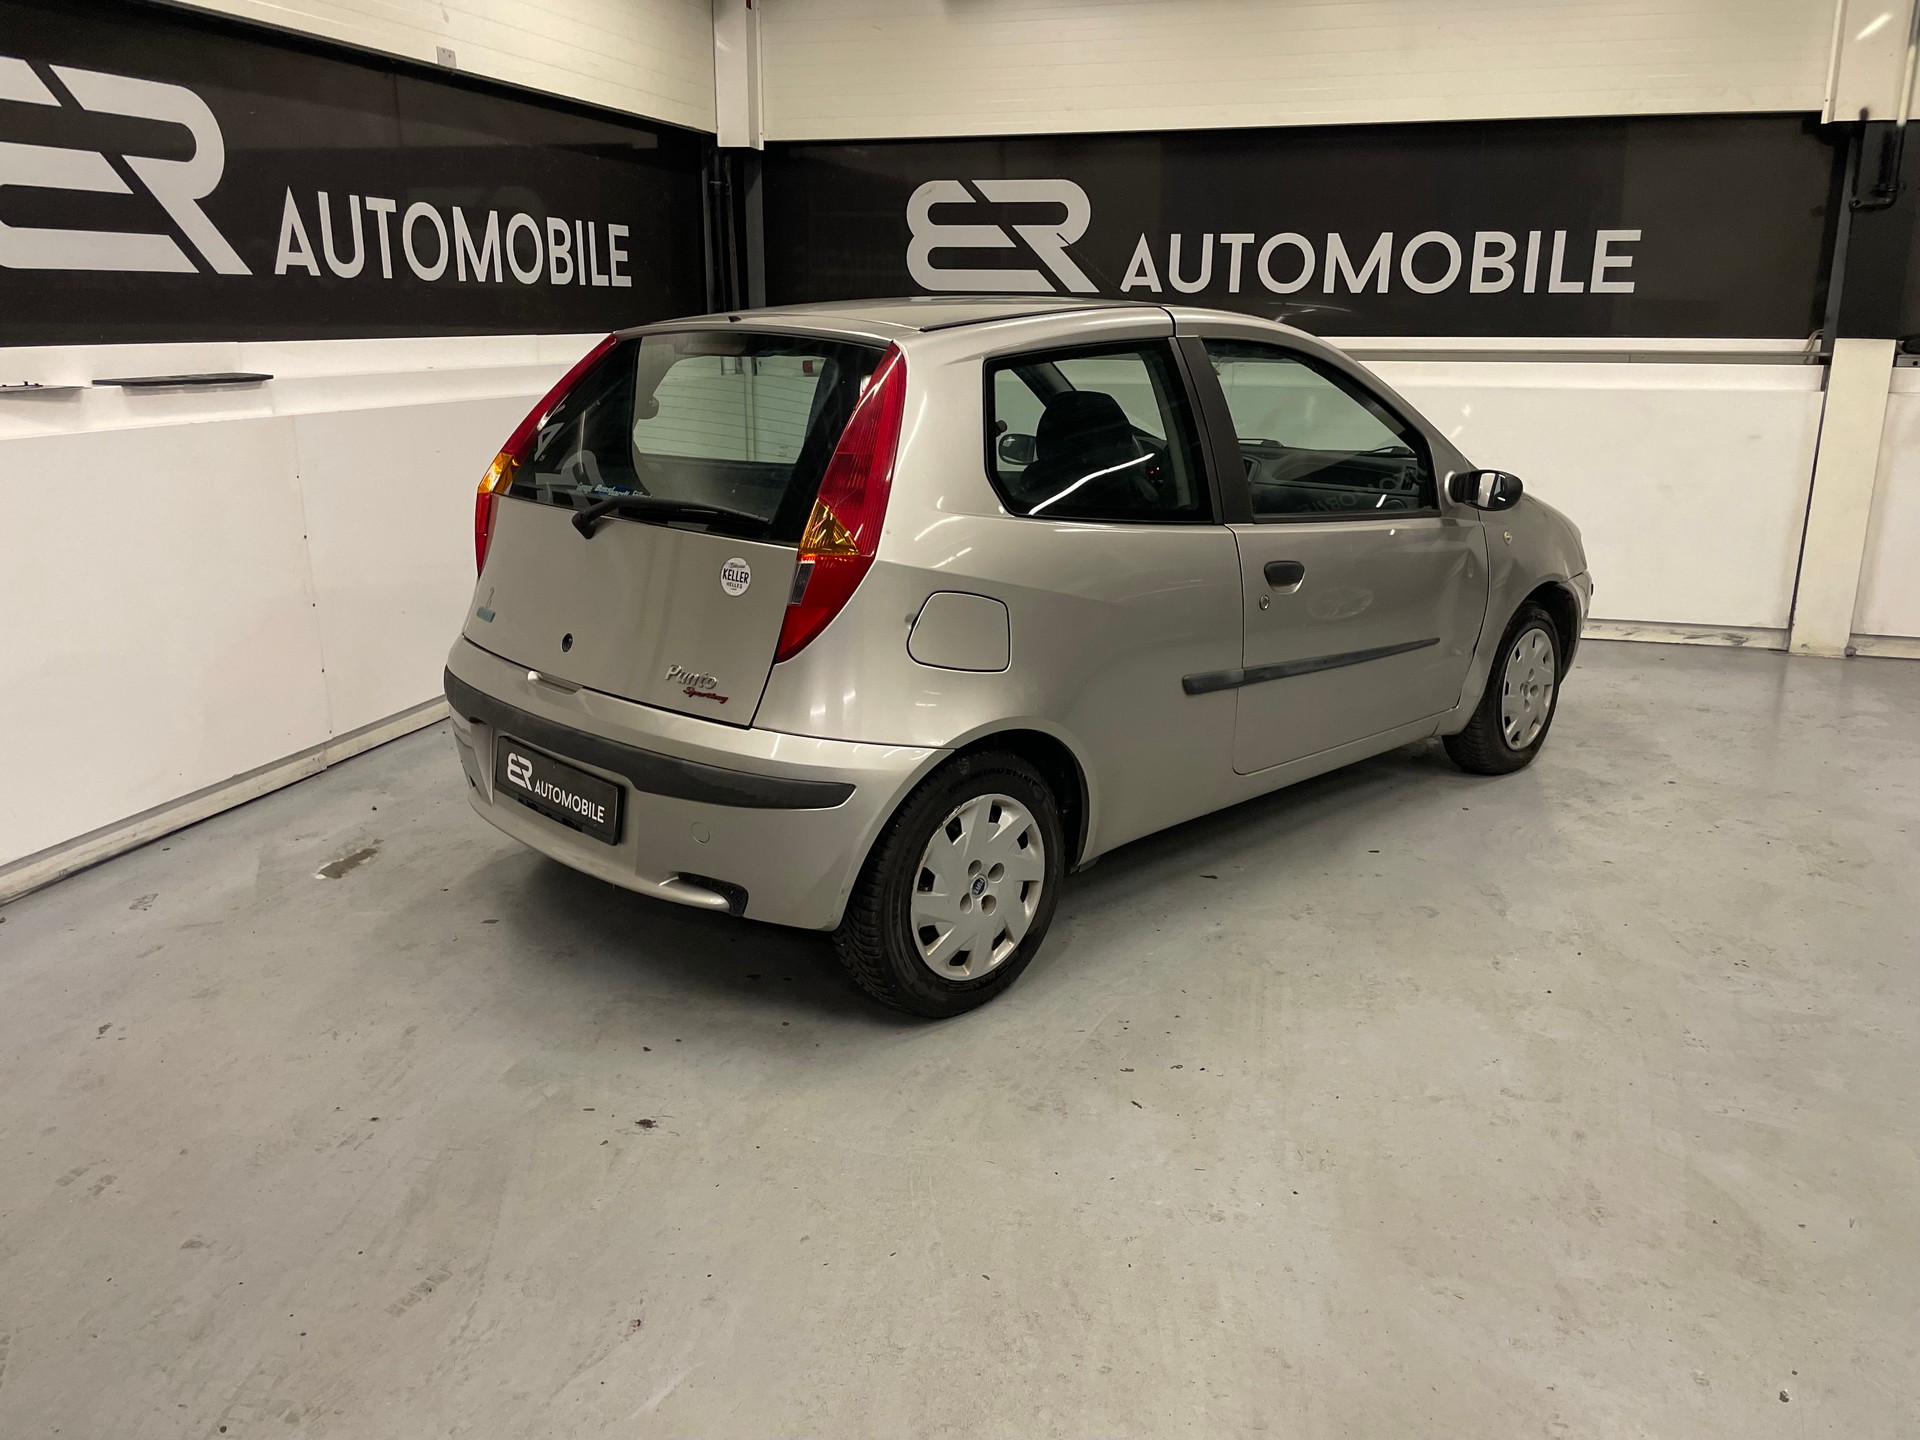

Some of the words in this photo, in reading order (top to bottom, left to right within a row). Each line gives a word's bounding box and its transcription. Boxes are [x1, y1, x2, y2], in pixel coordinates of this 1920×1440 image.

[274, 186, 632, 287] AUTOMOBILE
[1119, 229, 1642, 294] AUTOMOBILE
[722, 568, 749, 584] KELLER
[665, 664, 718, 690] Punto
[534, 779, 605, 823] AUTOMOBILE
